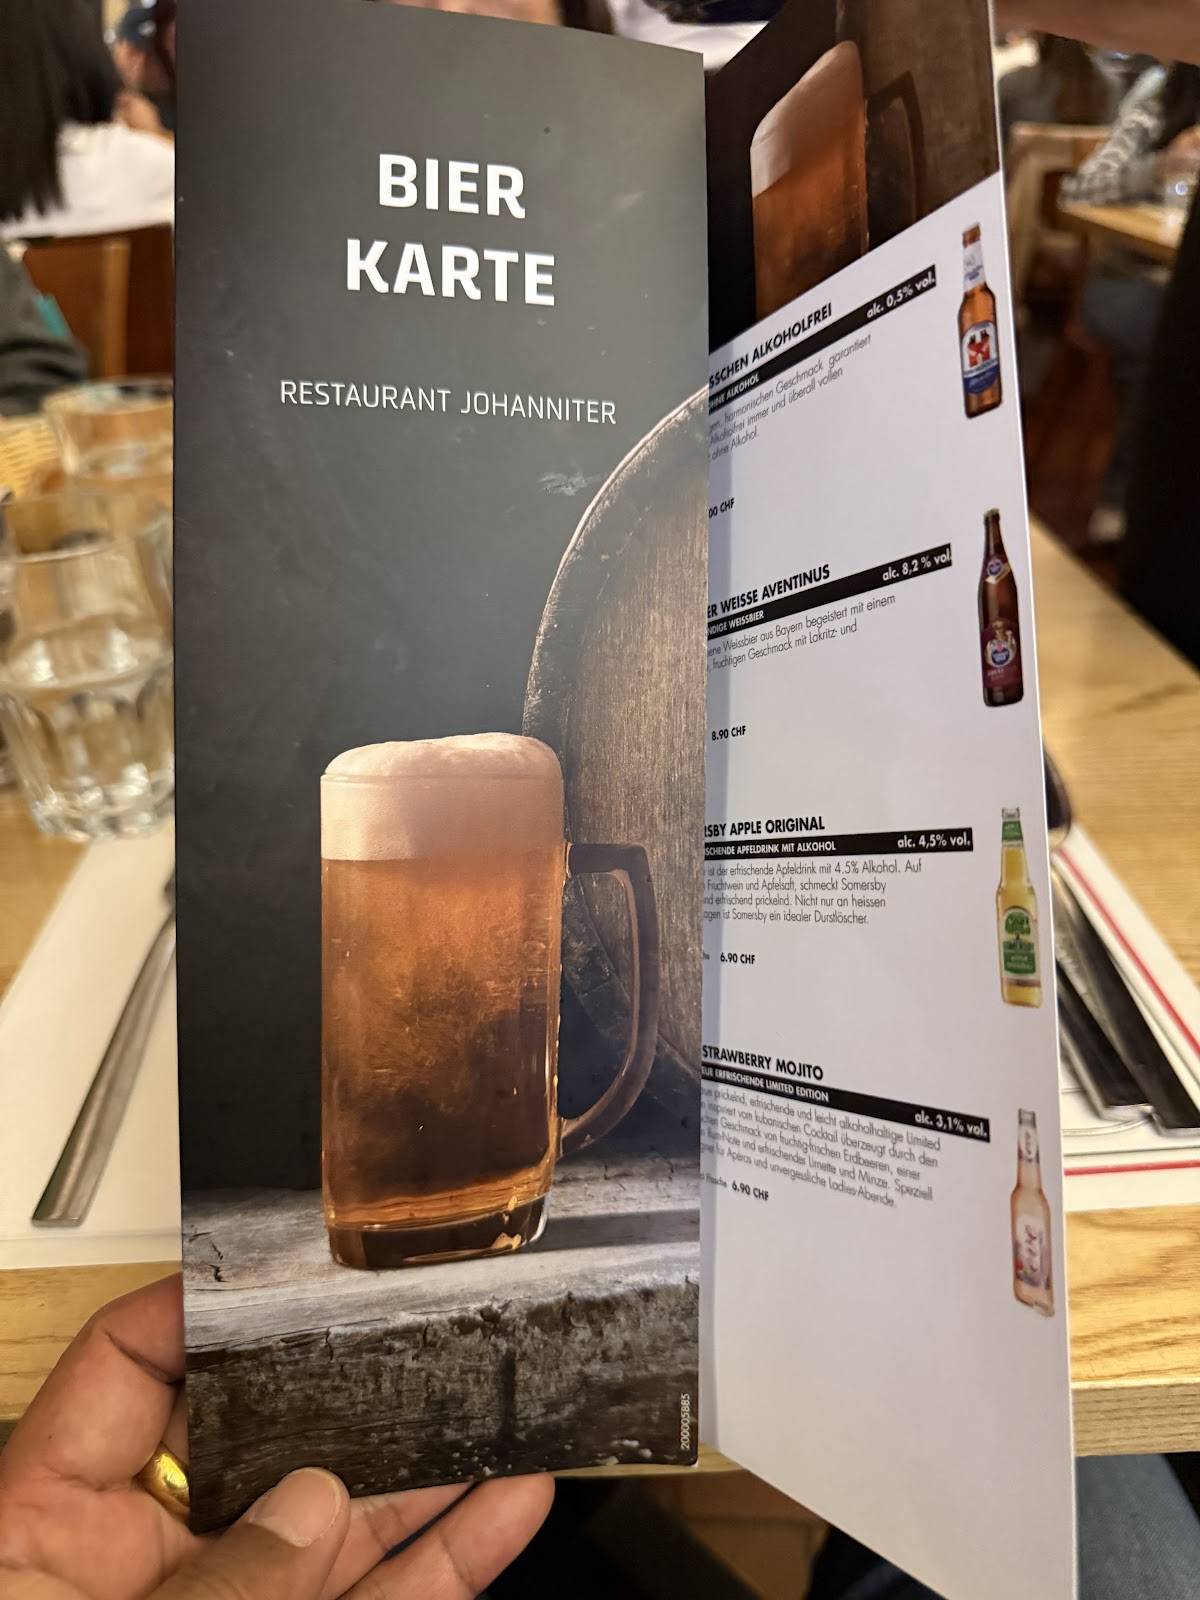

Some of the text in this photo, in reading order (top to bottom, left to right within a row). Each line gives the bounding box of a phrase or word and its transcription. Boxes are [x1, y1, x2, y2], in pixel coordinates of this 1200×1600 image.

[379, 153, 526, 219] BIER
[347, 238, 555, 306] KARTE
[866, 271, 935, 319] alc. 0,5% vol.
[752, 302, 832, 363] ALKOHOLFREI
[725, 334, 872, 422] harmonischen Geschmack garantiert
[726, 373, 760, 400] ALKOHOL
[280, 380, 617, 425] RESTAURANT JOHANNITER
[747, 406, 769, 426] immer
[771, 397, 786, 414] und
[788, 378, 817, 404] überall
[818, 366, 844, 388] vollen
[719, 497, 735, 513] CHF
[882, 567, 899, 582] alc.
[901, 558, 919, 578] 8,2
[920, 556, 932, 569] %
[720, 588, 758, 615] WEISSE
[761, 563, 830, 600] AVENTINUS
[722, 632, 758, 653] Weissbier
[761, 630, 774, 642] aus
[775, 621, 802, 641] Bayern
[805, 607, 848, 631] begeistert
[850, 600, 864, 615] mit
[866, 594, 896, 611] einem
[728, 610, 765, 630] WEISSBIER
[712, 620, 857, 670] fruchtigen Geschmack mit Lakritz- und
[711, 725, 747, 741] 8.90 CHF
[729, 820, 762, 836] APPLE
[765, 816, 825, 834] ORIGINAL
[897, 832, 971, 849] alc. 4,5% vol.
[736, 843, 779, 855] APFELDRINK
[781, 842, 795, 853] MIT
[796, 840, 836, 852] ALKOHOL
[716, 863, 728, 876] der
[729, 862, 774, 876] erfrischende
[775, 860, 817, 879] Apfeldrink
[819, 861, 832, 874] mit
[834, 861, 860, 875] 4.5%
[861, 858, 901, 874] Alkohol.
[904, 857, 922, 873] Auf
[707, 877, 887, 896] Fruchtwein und Apfelsaft, schmeckt Somersby
[715, 893, 752, 906] erfrischend
[755, 893, 792, 909] prickelnd.
[794, 893, 819, 907] Nicht
[820, 896, 834, 907] nur
[836, 897, 849, 907] an
[851, 894, 886, 908] heissen
[722, 909, 731, 921] ist
[732, 908, 767, 926] Somersby
[769, 910, 781, 922] ein
[783, 910, 811, 923] idealer
[814, 911, 869, 924] Durstlöscher.
[720, 952, 738, 964] 6.90
[740, 954, 756, 965] CHF
[702, 1044, 824, 1081] STRAWBERRY MOJITO
[714, 1068, 765, 1089] ERFRISCHENDE
[765, 1079, 794, 1096] LIMITED
[796, 1085, 829, 1103] EDITION
[737, 1109, 753, 1120] vom
[754, 1109, 801, 1133] kubanischen
[803, 1122, 838, 1143] Cocktail
[840, 1130, 886, 1157] überzeugt
[888, 1140, 916, 1162] durch
[918, 1150, 938, 1168] den
[749, 1097, 795, 1118] erfrischende
[796, 1104, 812, 1121] und
[814, 1108, 837, 1127] leicht
[839, 1113, 904, 1147] alkoholhaltige
[906, 1130, 941, 1151] Limited
[914, 1110, 988, 1138] alc. 3,1% vol.
[719, 1116, 762, 1139] Geschmack
[763, 1128, 778, 1141] von
[843, 1149, 894, 1176] Erdbeeren,
[896, 1165, 921, 1181] einer
[742, 1138, 756, 1151] und
[757, 1142, 807, 1165] erfrischender
[808, 1155, 837, 1175] Limette
[839, 1162, 856, 1180] und
[858, 1169, 890, 1190] Minze.
[894, 1176, 933, 1202] Speziell
[753, 1154, 768, 1170] und
[769, 1162, 827, 1187] unvergessliche
[731, 1181, 751, 1197] 6.90
[752, 1186, 770, 1202] CHF
[680, 1392, 691, 1451] 200005885
